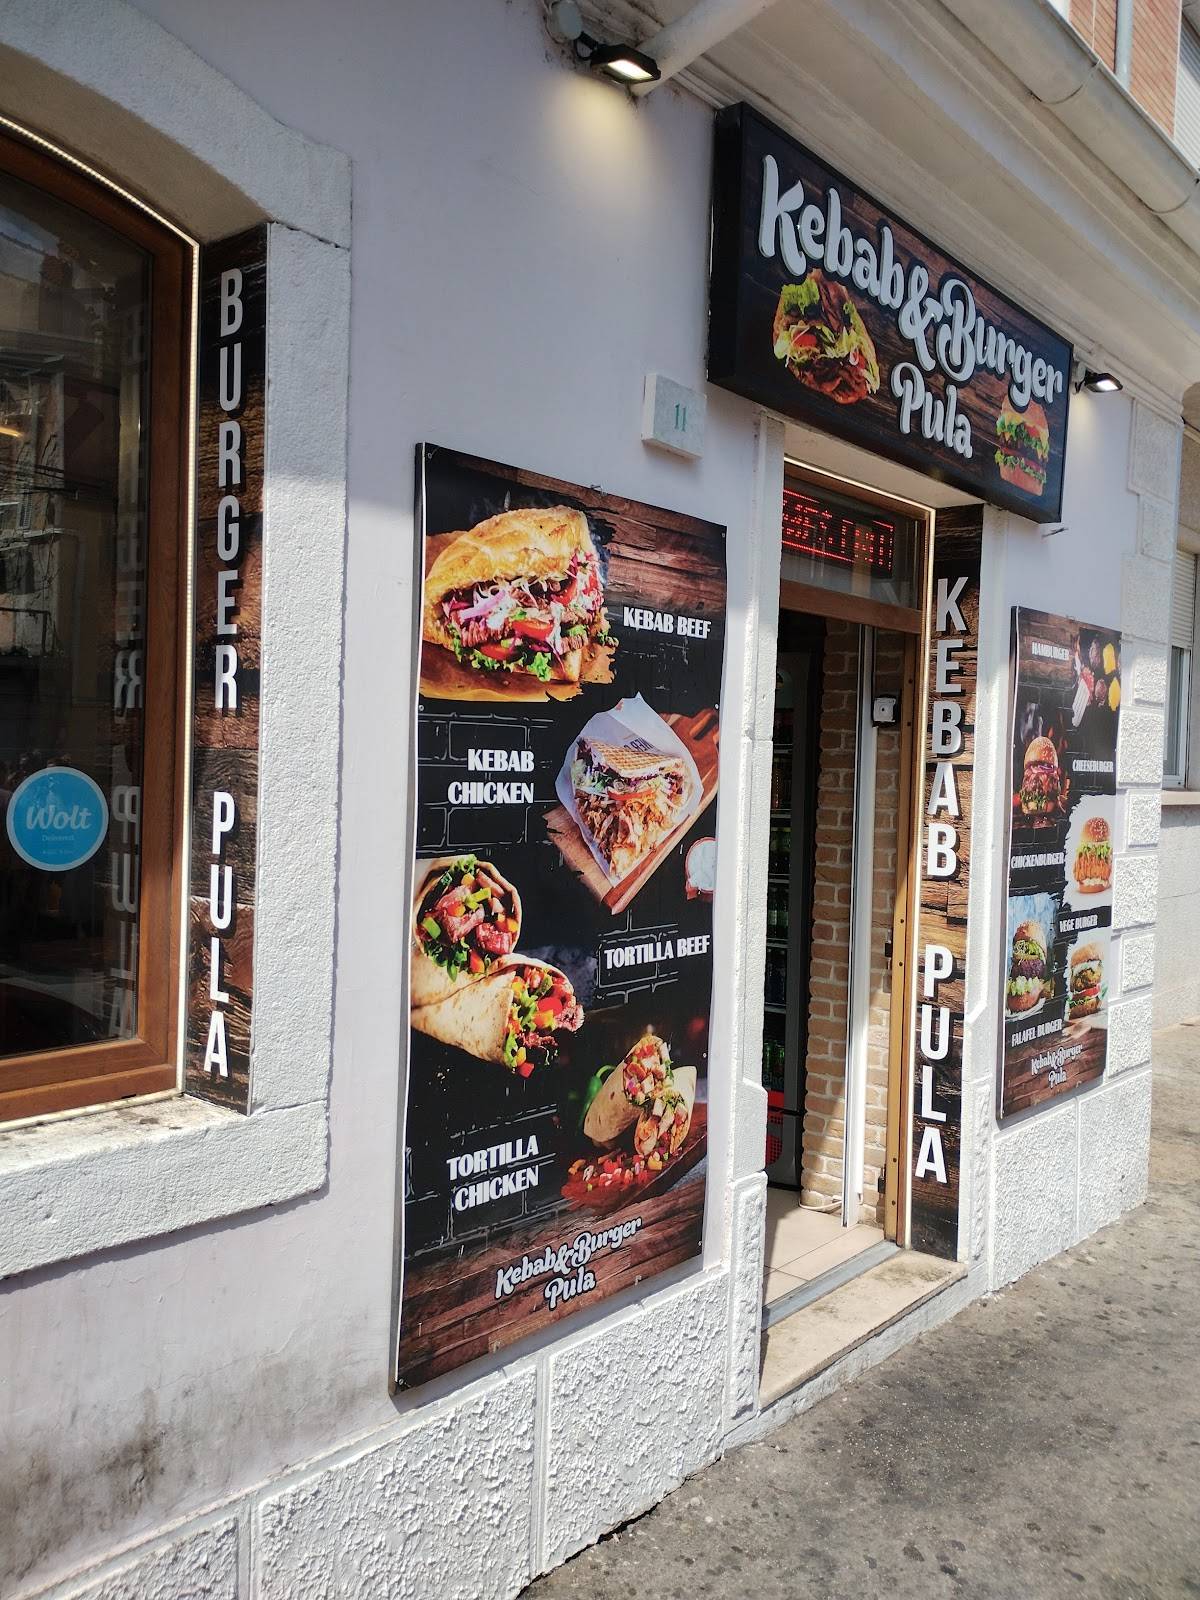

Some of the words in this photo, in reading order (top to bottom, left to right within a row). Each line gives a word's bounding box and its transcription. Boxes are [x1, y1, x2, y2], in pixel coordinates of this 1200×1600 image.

[757, 153, 1063, 409] Kebab&Burger
[891, 361, 973, 459] Pula
[214, 267, 244, 710] BURGER
[622, 606, 674, 634] KEBAB
[676, 616, 712, 640] BEEF
[1031, 641, 1070, 661] HAMBURGER
[926, 576, 969, 878] KEBAB
[467, 748, 535, 773] KEBAB
[1072, 758, 1114, 773] CHEESEBURGER
[447, 781, 534, 805] CHICKEN
[26, 804, 92, 830] Wolt
[1010, 851, 1065, 869] CHICKENBURGER
[203, 791, 235, 1078] PULA
[1059, 917, 1074, 933] VEGE
[1074, 914, 1098, 931] BURGER
[604, 943, 674, 971] TORTILLA
[675, 934, 711, 959] BEEF
[1011, 1026, 1037, 1048] FALAFEL
[1037, 1018, 1063, 1038] BURGER
[914, 943, 954, 1184] PULA
[1048, 1069, 1067, 1089] Pula
[447, 1134, 540, 1182] TORTILLA
[454, 1165, 540, 1213] CHICKEN
[494, 1216, 643, 1299] Kebab&Burger
[543, 1269, 598, 1310] Pula
